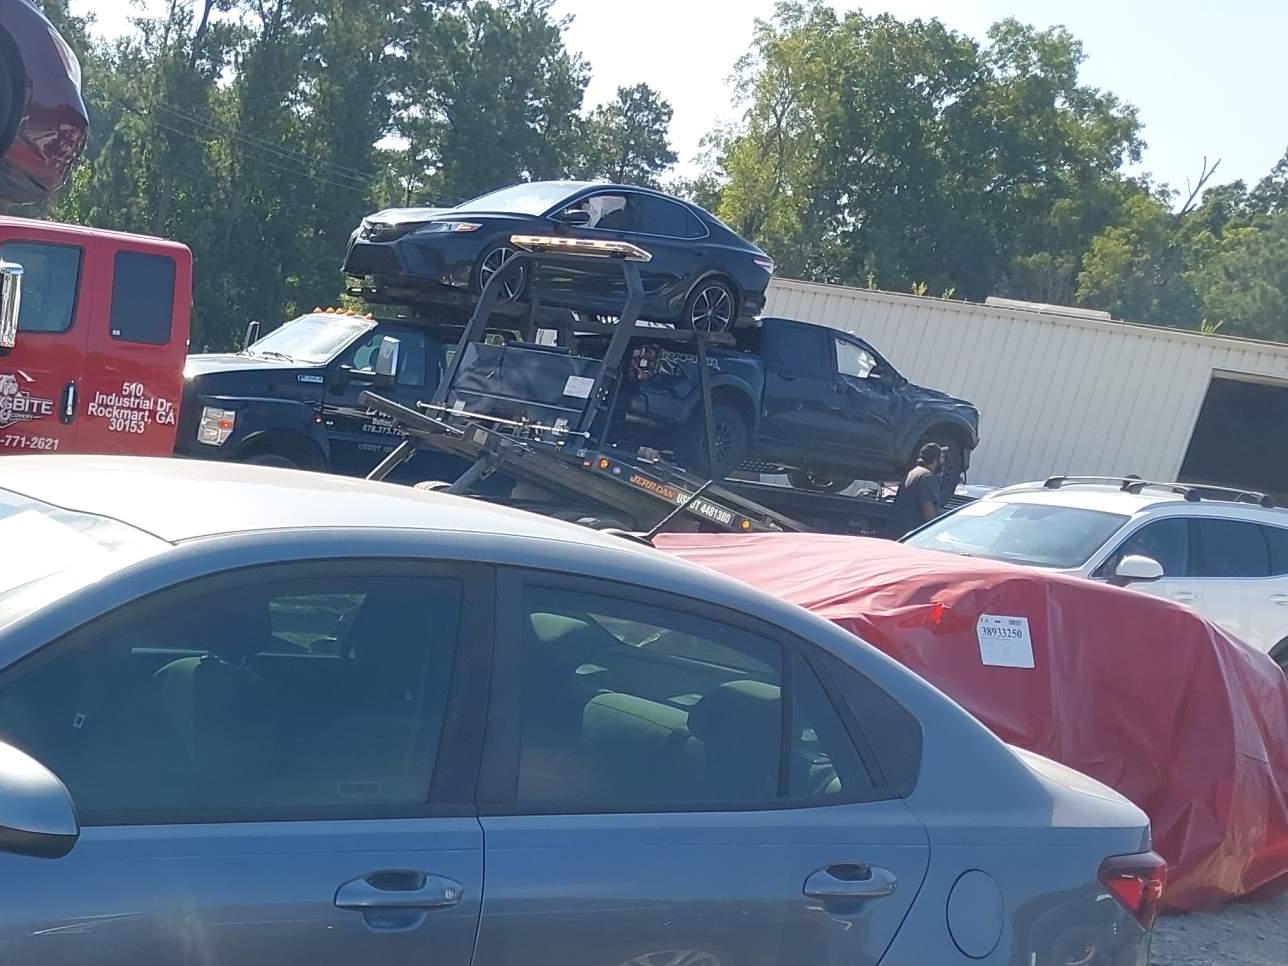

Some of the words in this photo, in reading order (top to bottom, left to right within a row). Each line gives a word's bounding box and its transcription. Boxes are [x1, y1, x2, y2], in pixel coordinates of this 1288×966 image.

[122, 381, 144, 397] 510
[95, 391, 154, 410] Industrial
[87, 402, 152, 425] Rockmart,
[155, 410, 175, 425] GA
[108, 418, 145, 434] 30153
[981, 626, 1023, 639] 38933250
